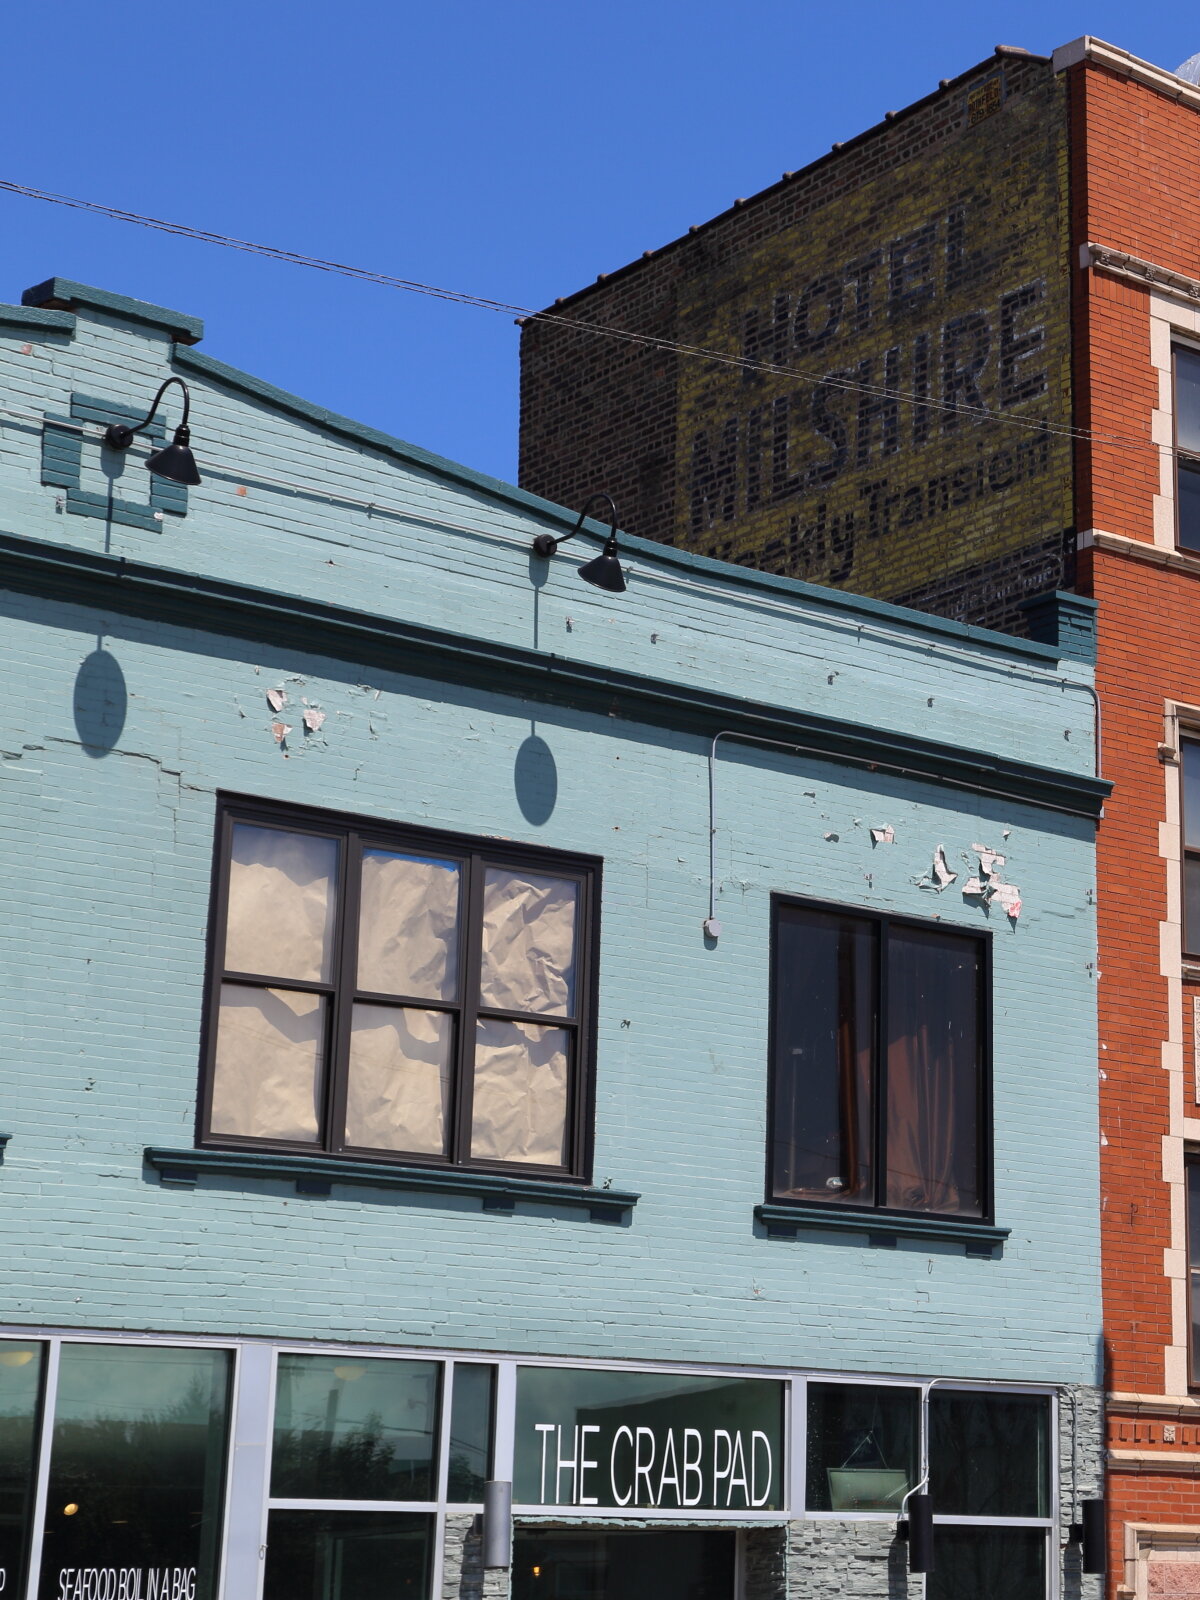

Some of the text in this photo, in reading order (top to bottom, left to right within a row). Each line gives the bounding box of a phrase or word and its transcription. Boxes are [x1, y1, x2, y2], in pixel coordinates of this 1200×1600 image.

[742, 205, 1000, 388] HOTEL
[690, 276, 1049, 534] MILSHIRE
[535, 1423, 772, 1507] THE CRAB PAD
[57, 1567, 197, 1600] SEAFOOD BOIL IN A BAG
